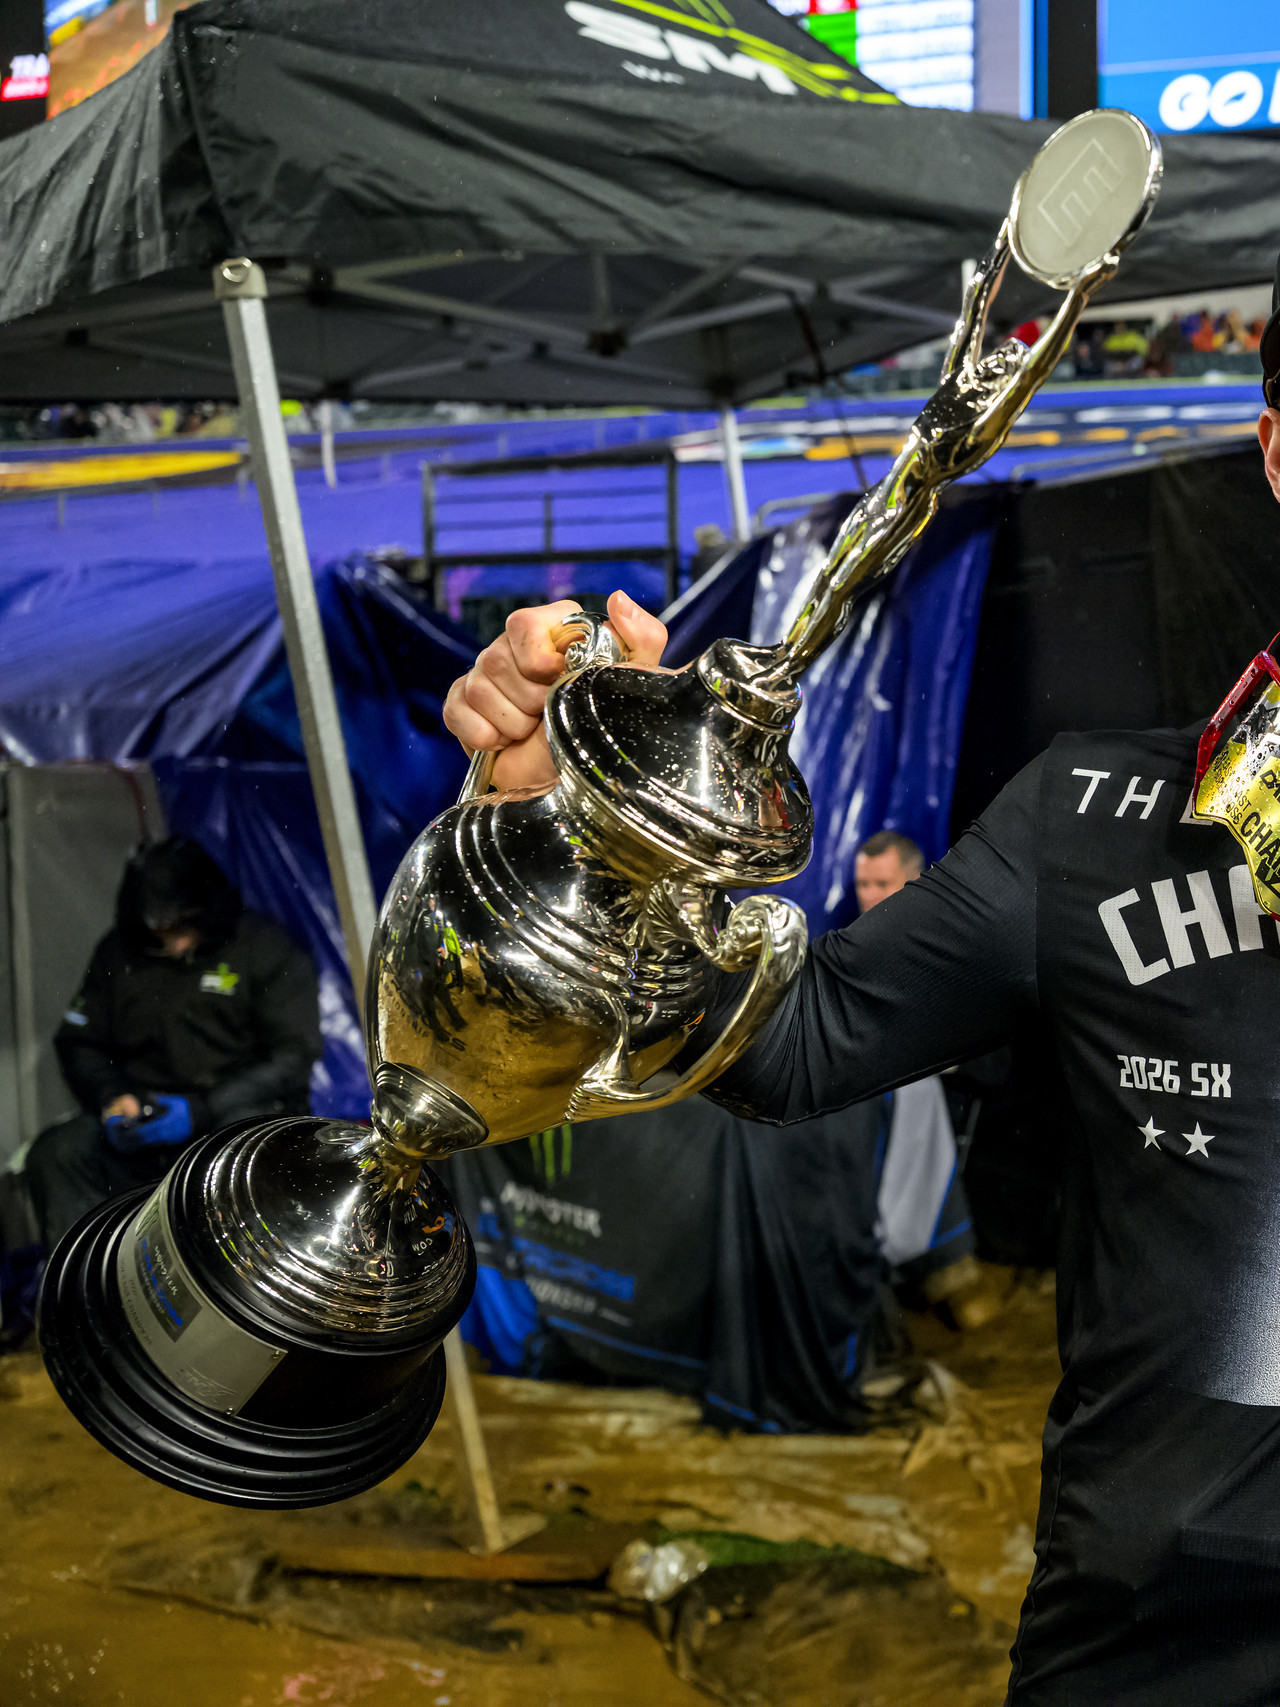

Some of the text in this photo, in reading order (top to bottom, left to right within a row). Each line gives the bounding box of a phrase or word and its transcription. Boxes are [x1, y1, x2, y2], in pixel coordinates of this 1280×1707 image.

[1159, 74, 1264, 131] GO
[1117, 1054, 1232, 1098] 2026 SX
